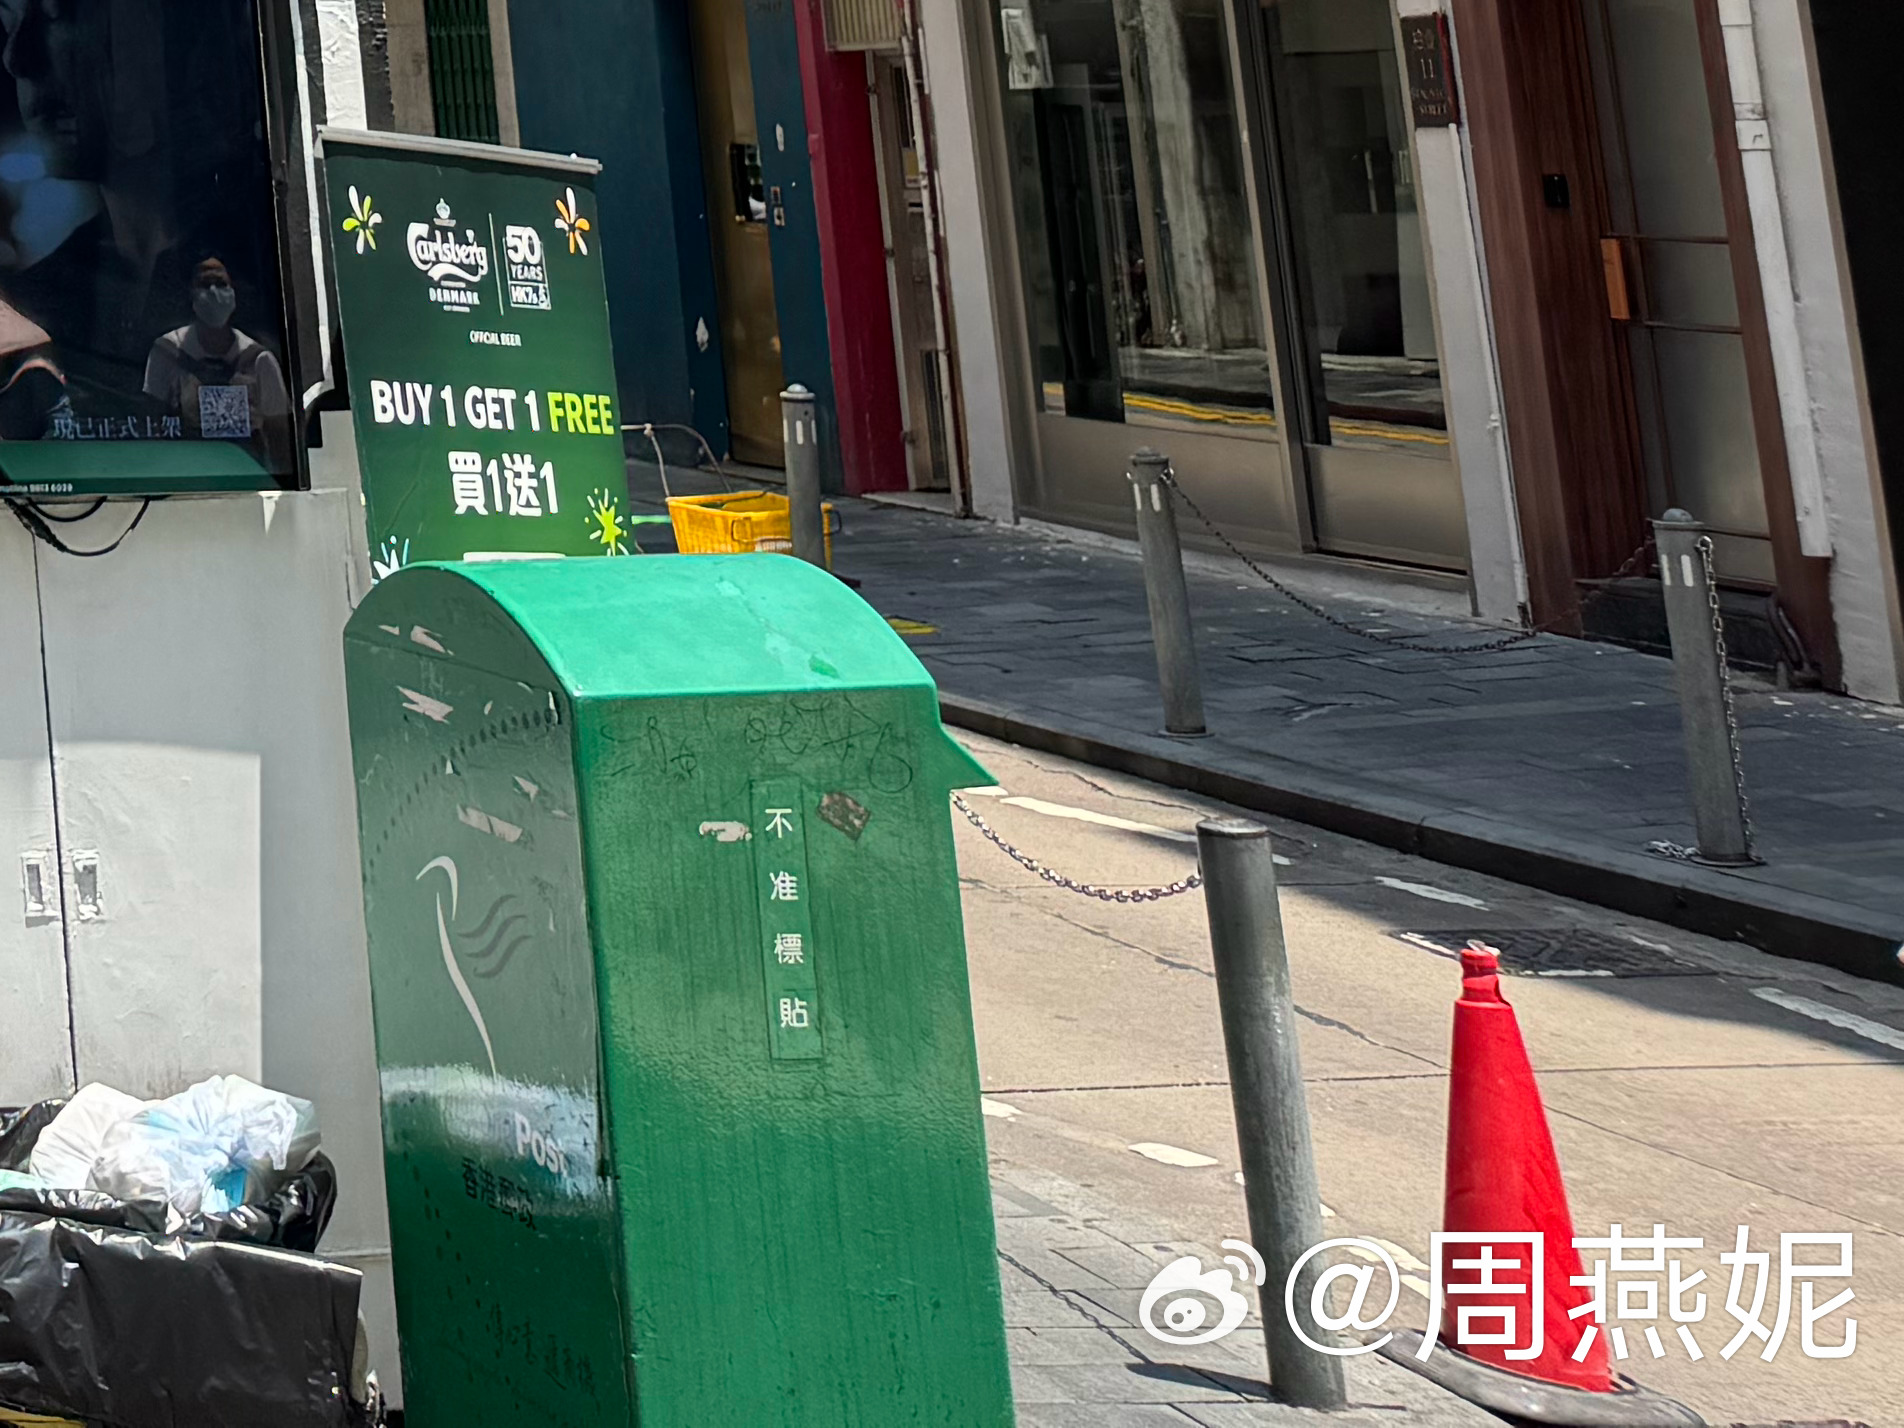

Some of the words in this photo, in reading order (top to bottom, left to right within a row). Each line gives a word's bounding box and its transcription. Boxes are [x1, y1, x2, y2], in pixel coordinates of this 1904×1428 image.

[407, 222, 488, 282] Carlsberg
[506, 225, 541, 264] 50
[510, 264, 543, 281] YEARS
[371, 380, 432, 426] BUY
[440, 384, 456, 427] 1
[464, 385, 517, 431] GET
[524, 388, 540, 432] 1
[548, 391, 614, 435] FREE
[448, 450, 559, 517] 買1送1
[764, 807, 810, 1030] 不准標貼
